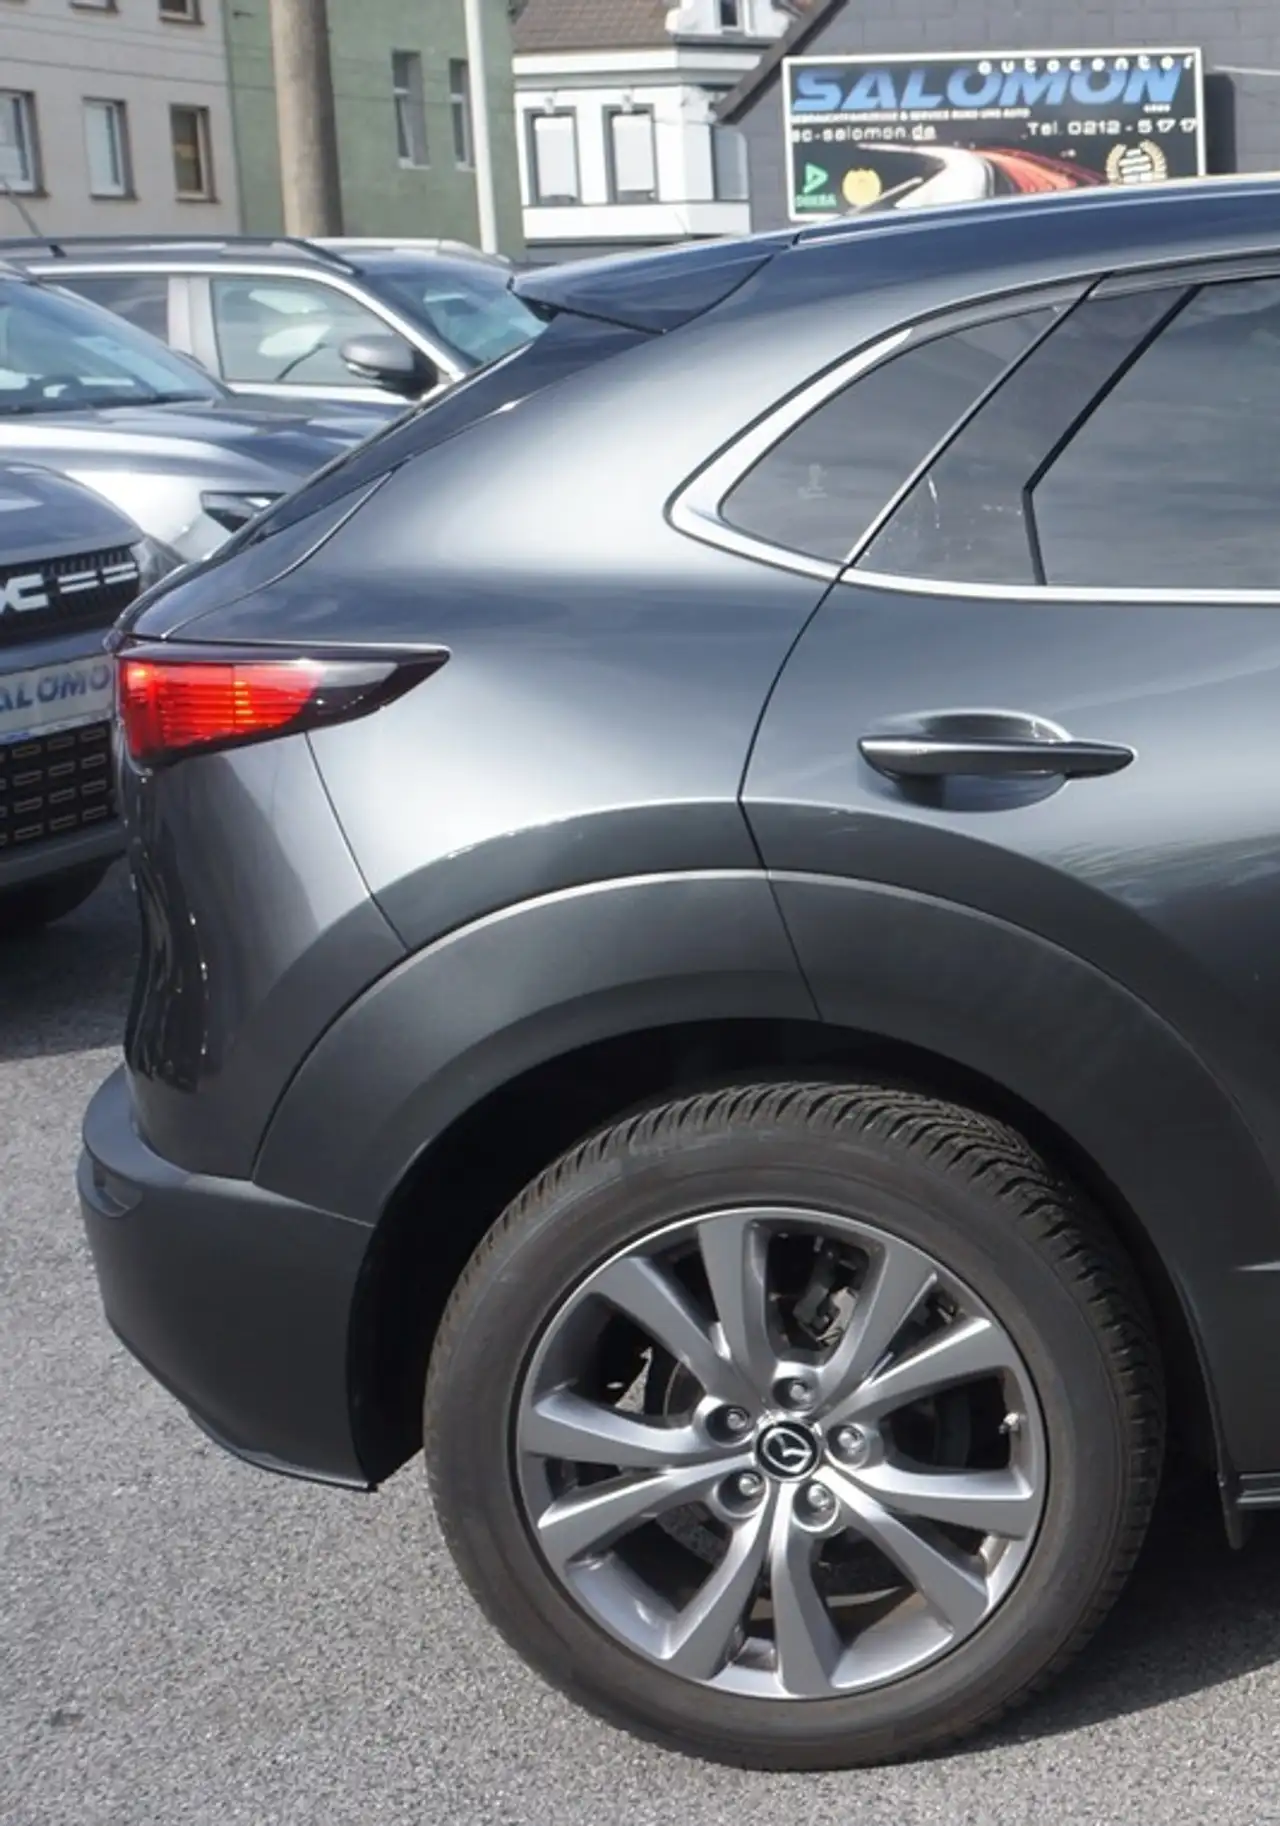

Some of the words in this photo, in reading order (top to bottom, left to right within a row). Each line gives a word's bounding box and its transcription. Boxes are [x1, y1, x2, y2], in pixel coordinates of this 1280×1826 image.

[977, 54, 1194, 76] autocenter
[793, 62, 1182, 112] SALOMON
[1067, 120, 1122, 135] 0212
